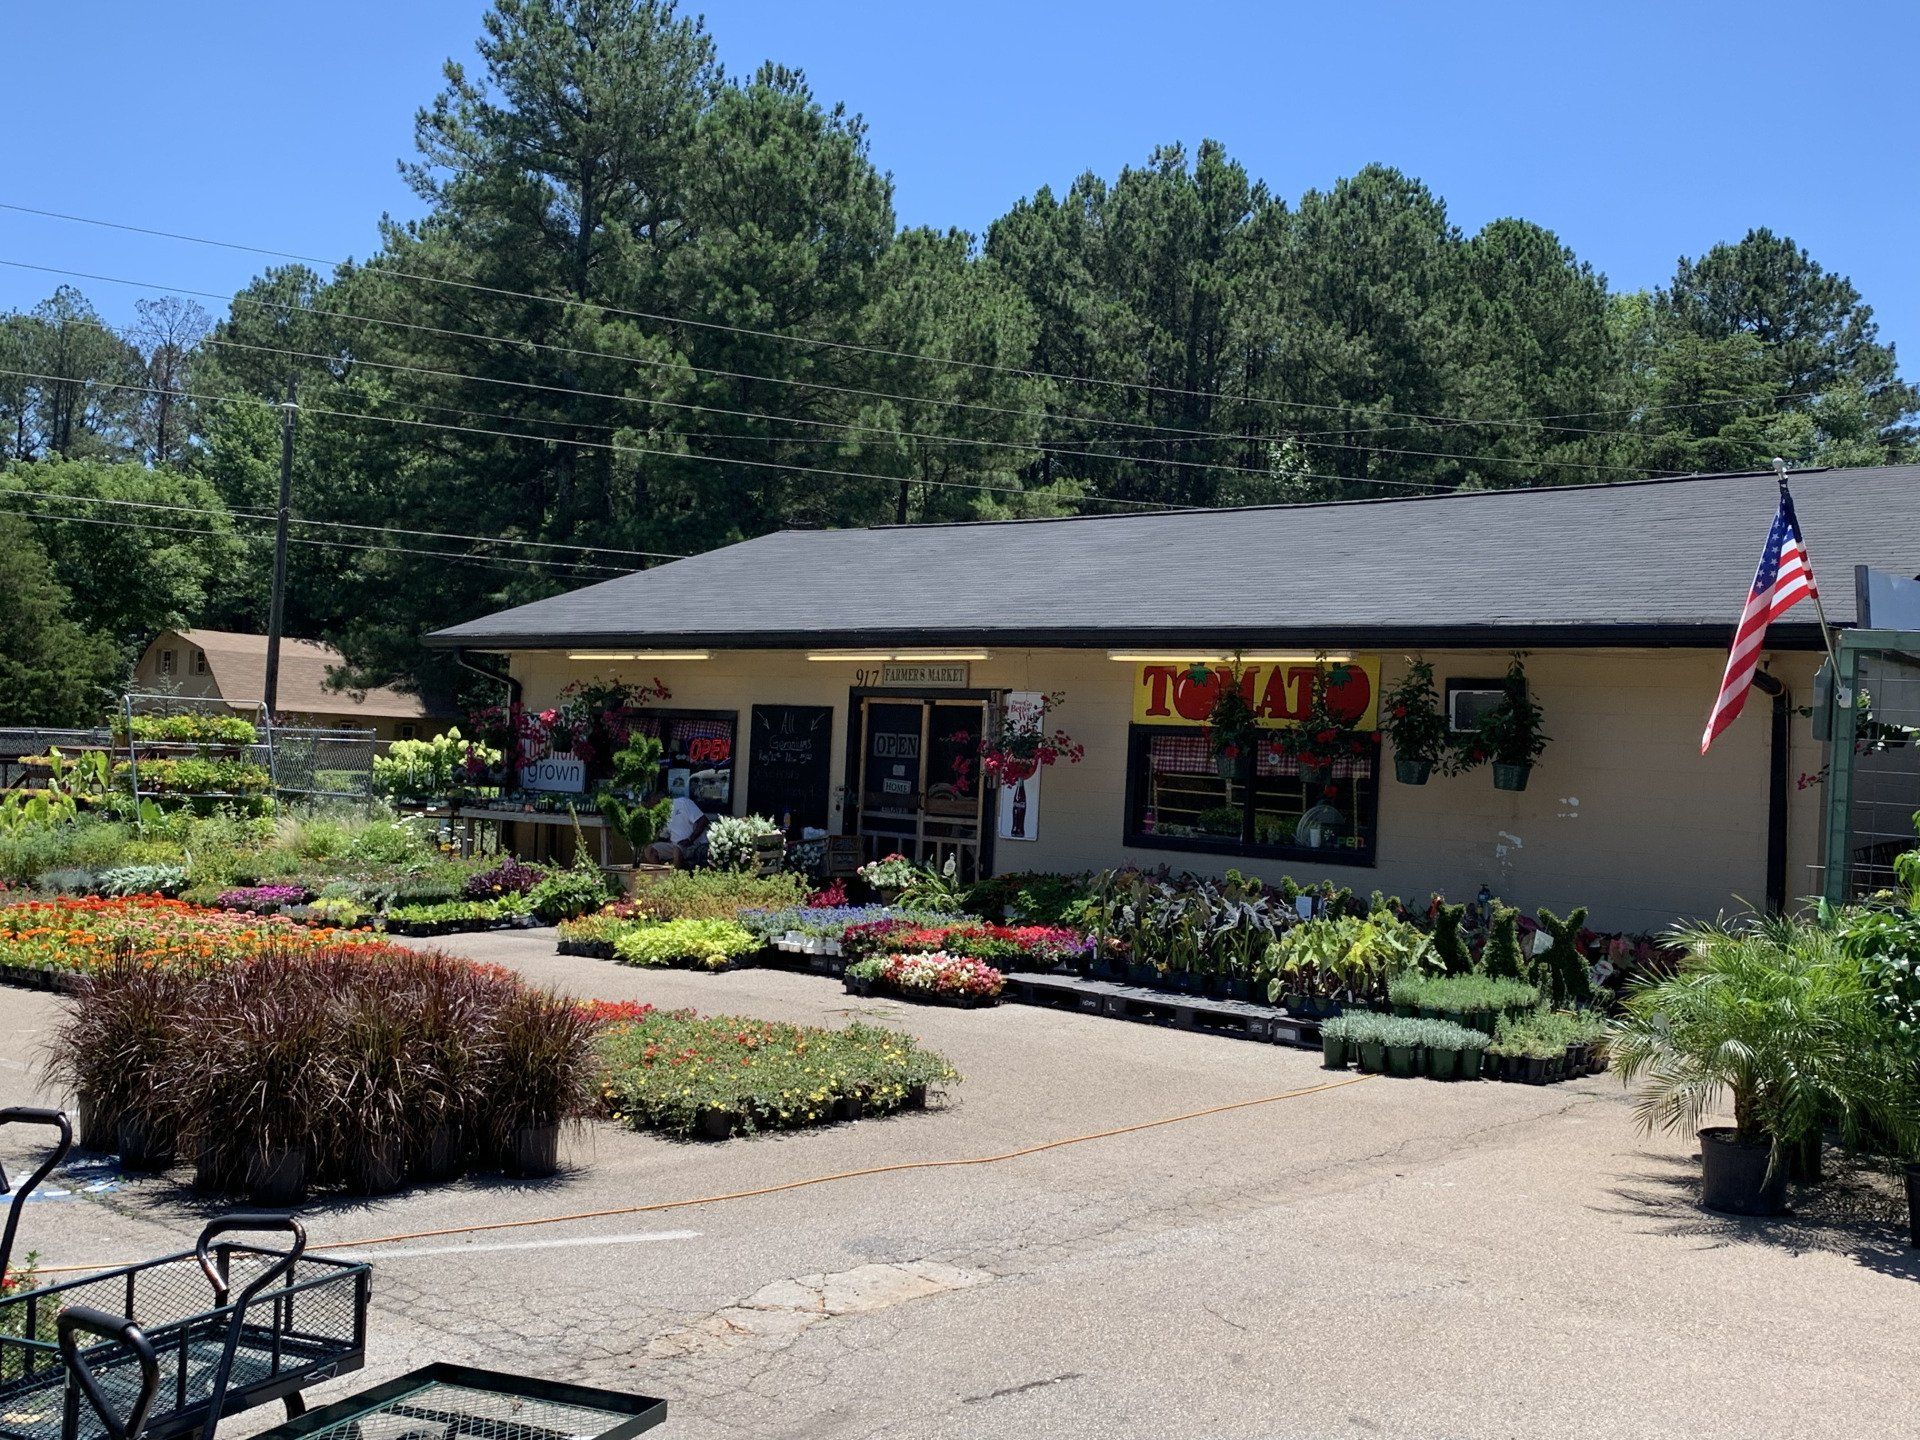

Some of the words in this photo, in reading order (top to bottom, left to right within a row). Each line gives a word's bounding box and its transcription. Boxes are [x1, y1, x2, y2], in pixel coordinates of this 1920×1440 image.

[855, 668, 880, 688] 917
[929, 668, 965, 683] MARKET
[780, 711, 796, 735] All
[690, 738, 731, 761] OPEN
[877, 735, 918, 755] OPEN
[528, 764, 580, 783] grown
[885, 781, 909, 793] HOME
